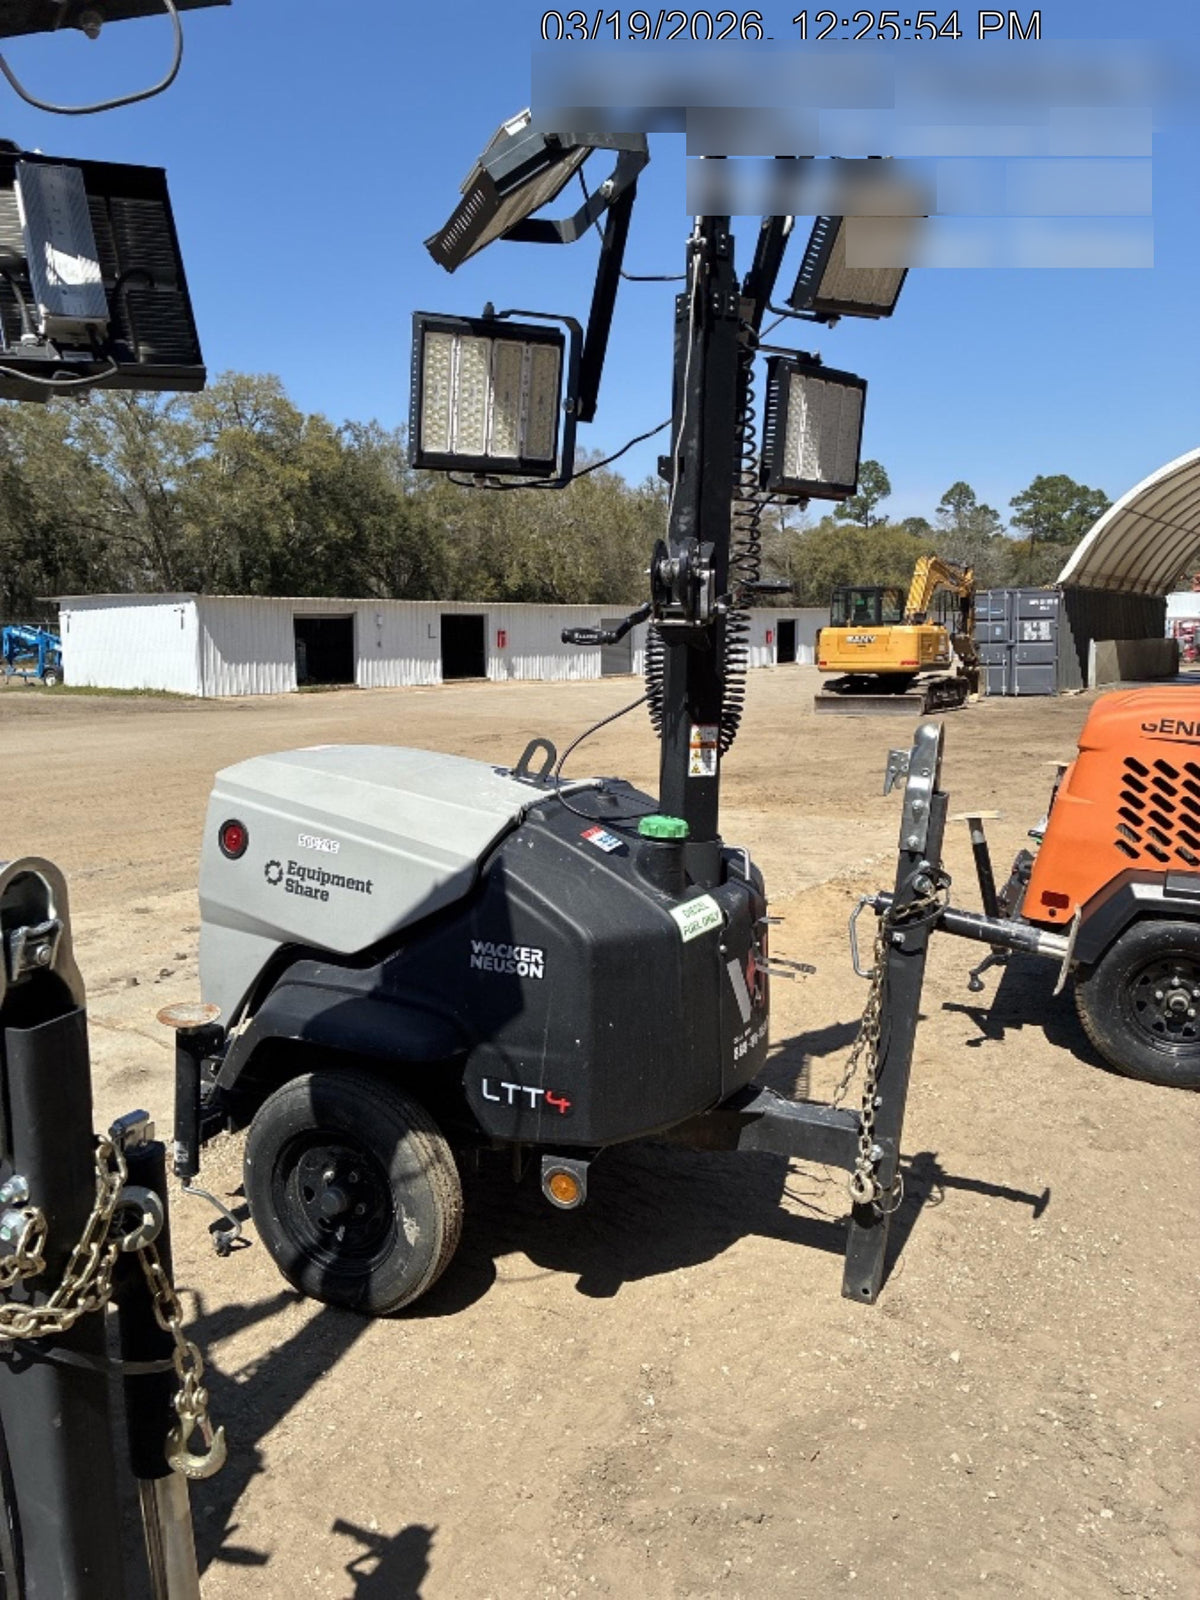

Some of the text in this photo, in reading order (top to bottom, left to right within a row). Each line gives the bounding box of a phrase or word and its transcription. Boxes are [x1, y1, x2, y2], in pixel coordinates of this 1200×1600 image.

[1141, 718, 1200, 737] GEN
[285, 878, 330, 902] Share
[287, 860, 374, 895] Equipment
[471, 939, 545, 965] WACKER
[470, 954, 545, 979] NEUSON
[482, 1078, 572, 1114] LTT4
